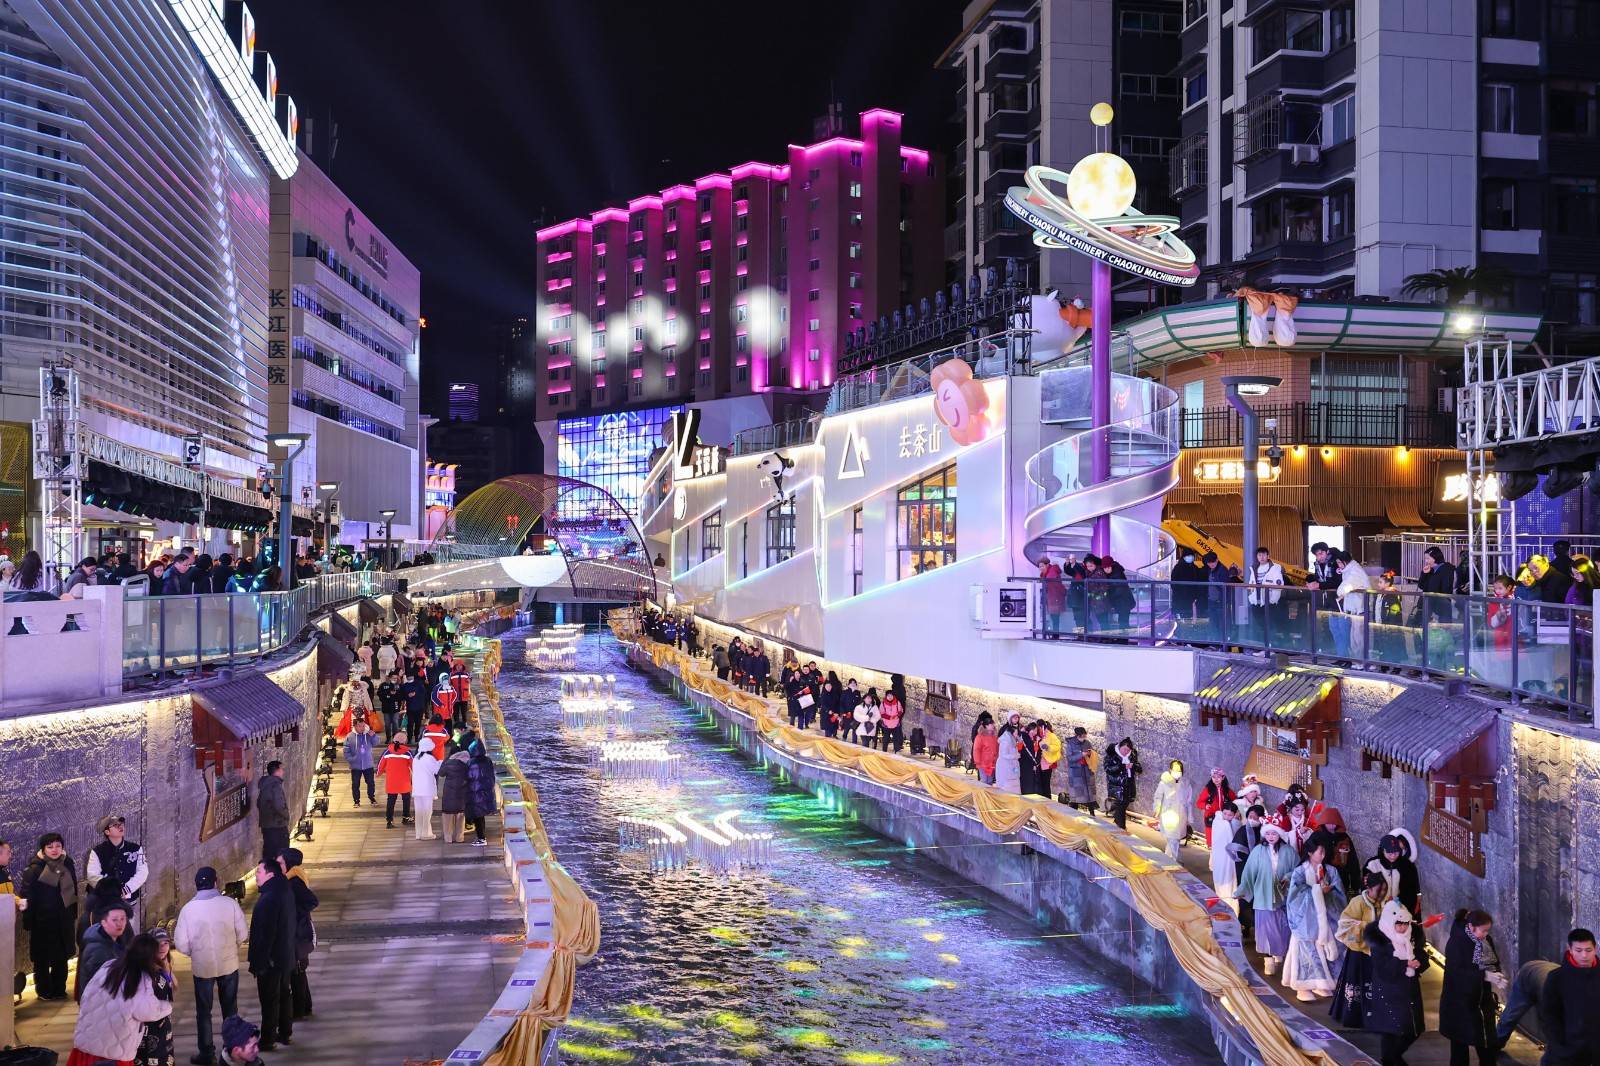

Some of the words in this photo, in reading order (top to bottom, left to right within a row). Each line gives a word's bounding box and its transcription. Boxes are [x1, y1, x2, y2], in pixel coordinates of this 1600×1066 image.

[1028, 214, 1058, 236] CHAOKU
[1057, 230, 1107, 259] MACHINERY
[1109, 255, 1145, 274] CHAOKU
[1144, 268, 1183, 284] MACHINERY
[268, 288, 286, 384] 长江医院
[898, 423, 942, 458] 去茶山
